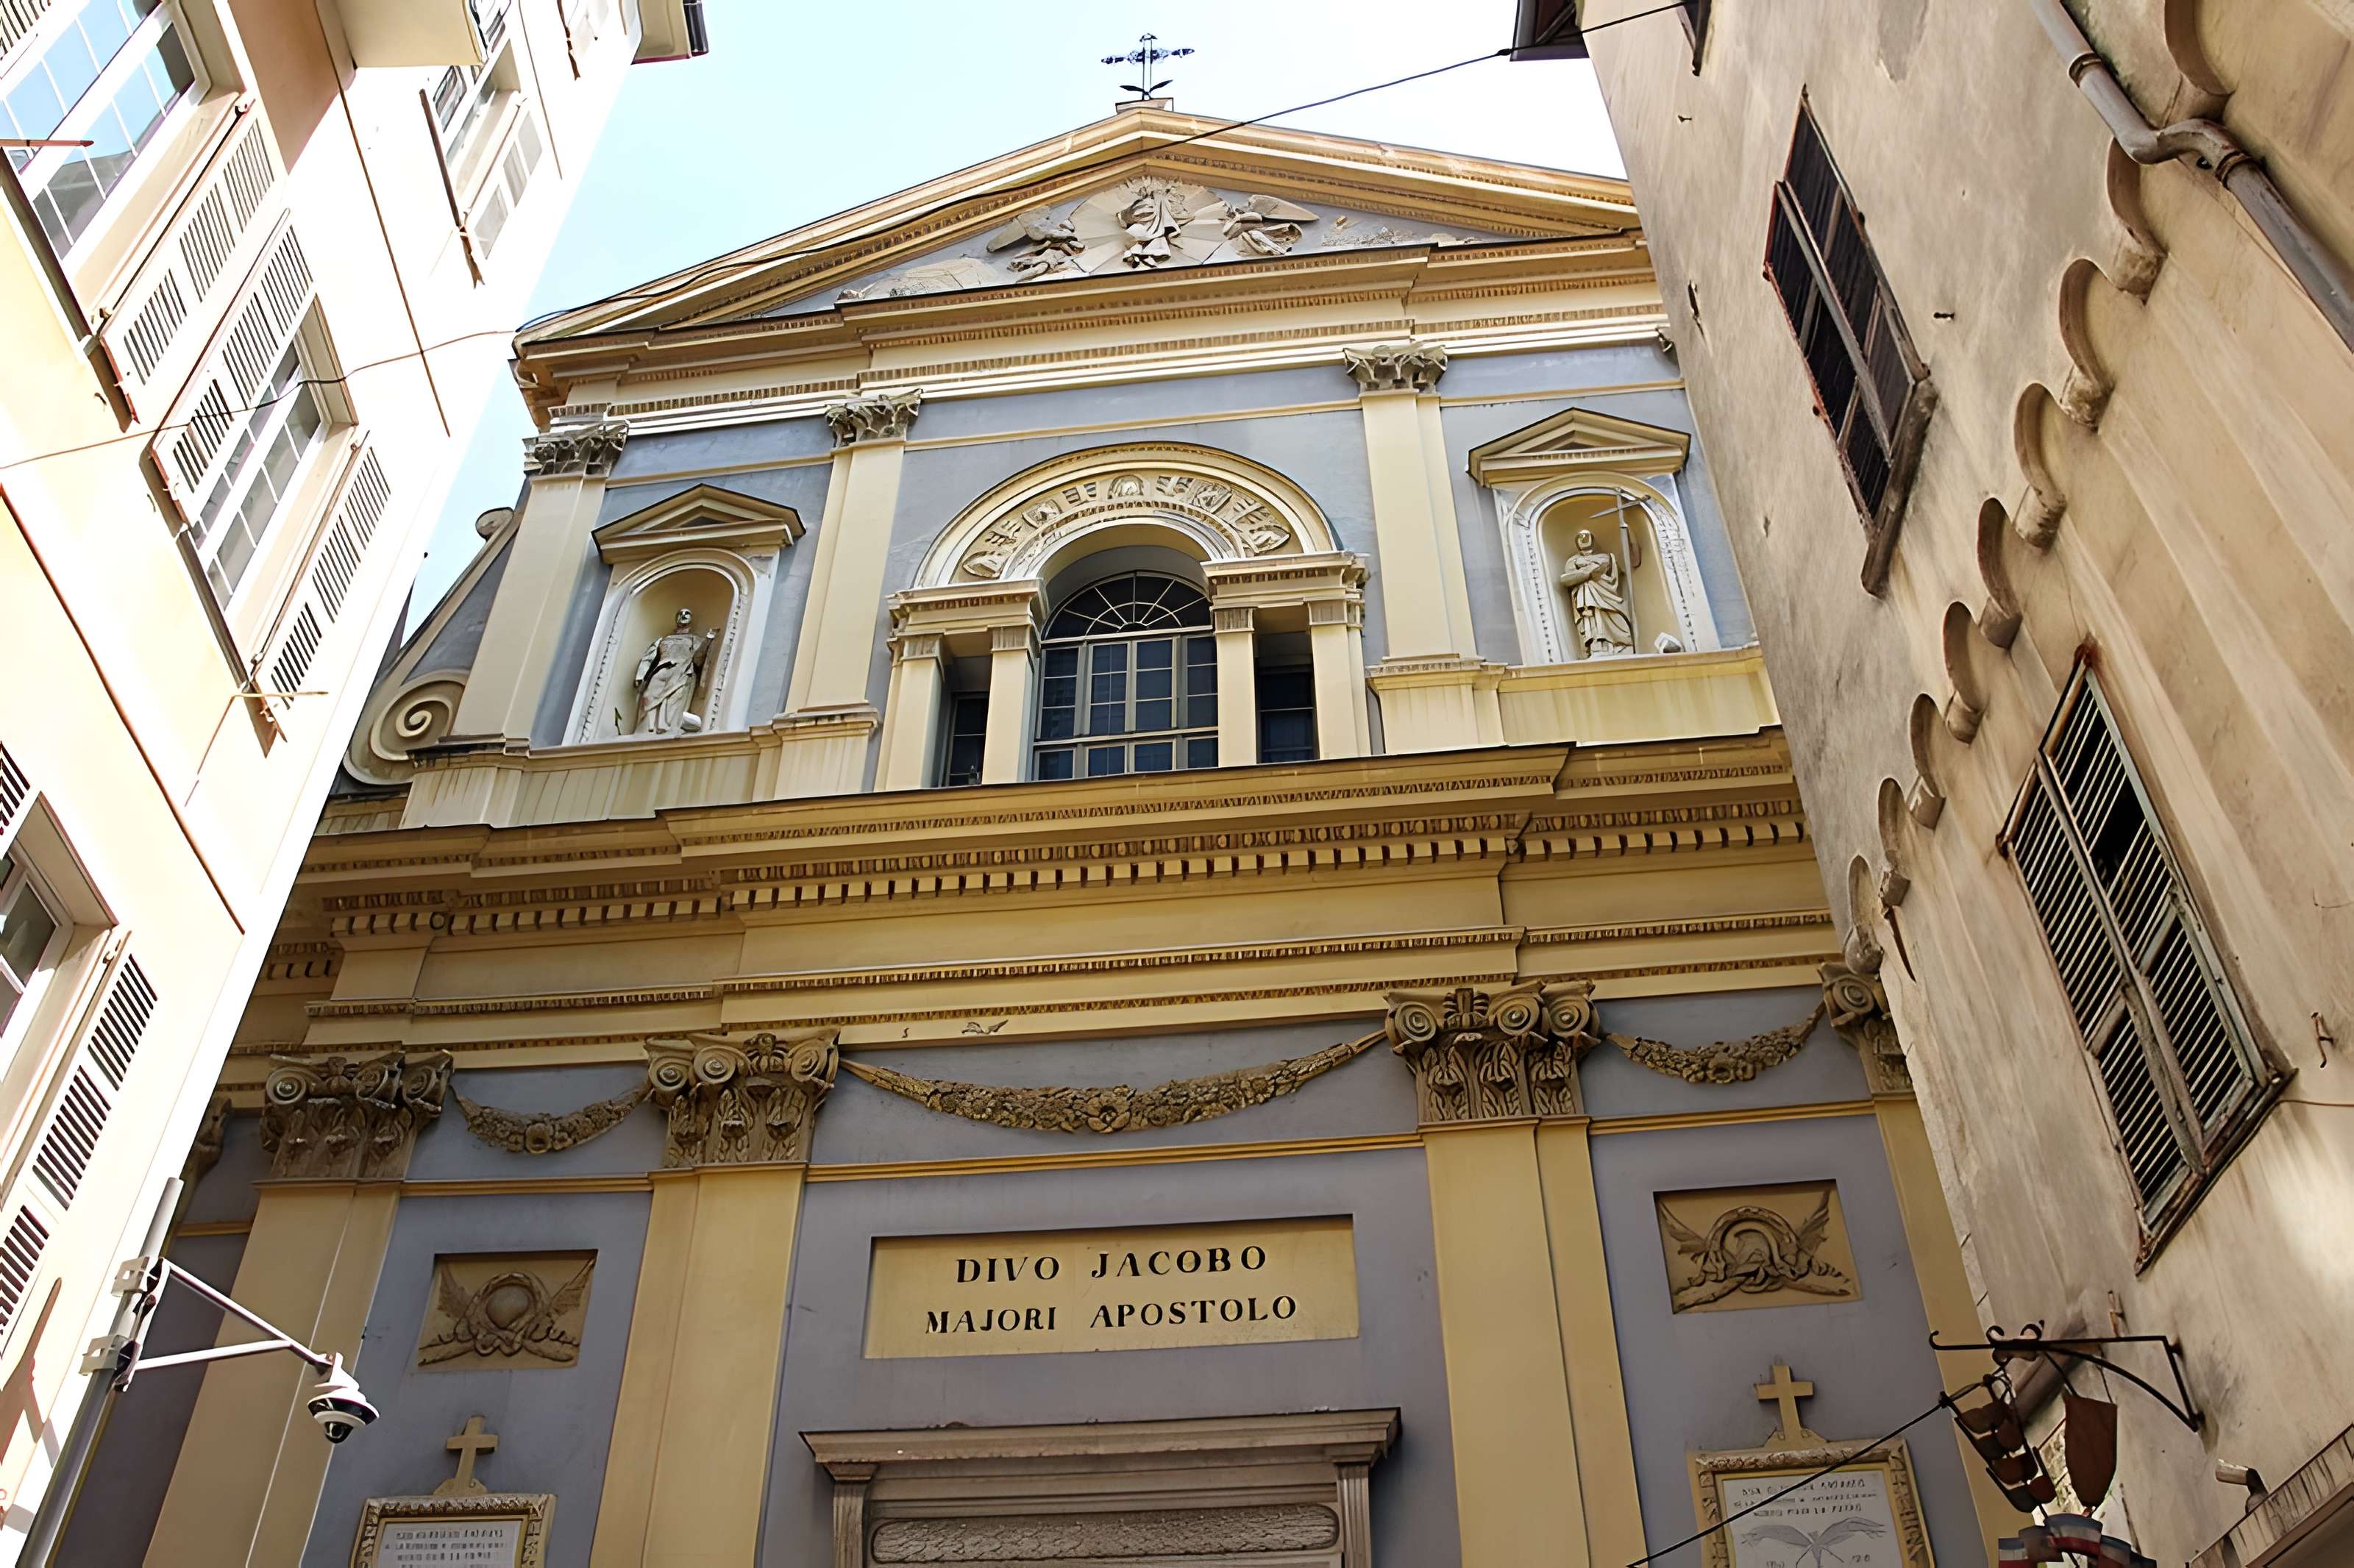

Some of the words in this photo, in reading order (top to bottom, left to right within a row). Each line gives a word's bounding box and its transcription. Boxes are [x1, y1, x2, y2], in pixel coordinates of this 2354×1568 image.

[956, 1255, 1060, 1283] DIVO
[1090, 1245, 1267, 1278] JACOBO
[925, 1306, 1057, 1334] MAJORI
[1089, 1294, 1298, 1328] APOSTOLO
